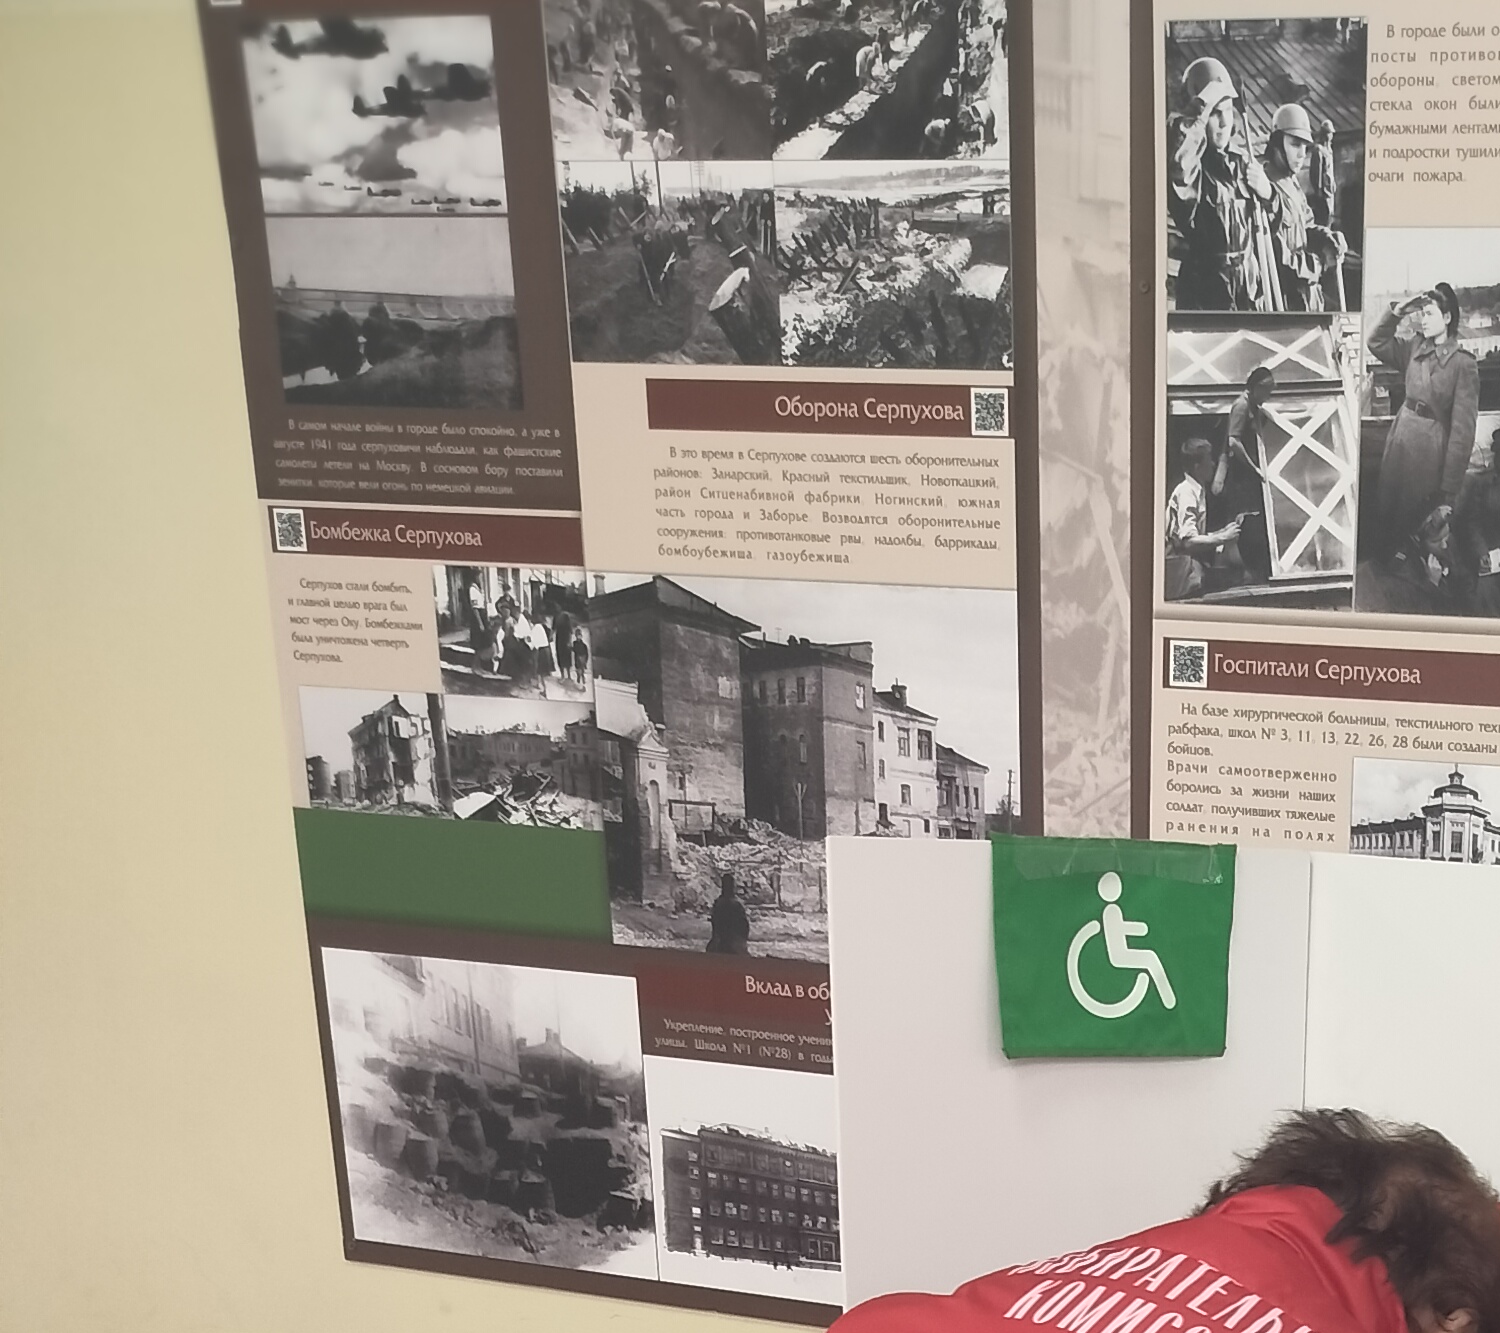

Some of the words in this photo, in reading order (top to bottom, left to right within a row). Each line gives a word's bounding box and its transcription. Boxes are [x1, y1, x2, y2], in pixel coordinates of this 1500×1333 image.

[1401, 27, 1447, 42] городе
[1451, 21, 1486, 38] были
[1370, 52, 1417, 64] посты
[1369, 100, 1413, 112] стекла
[1424, 100, 1457, 111] окон
[1369, 120, 1447, 139] бумажными
[1382, 148, 1450, 162] подростки
[1368, 171, 1405, 183] очаги
[775, 395, 859, 422] Оборона
[864, 398, 964, 424] Серпухова
[680, 449, 698, 459] это
[701, 450, 734, 462] время
[747, 448, 807, 464] Серпухове
[905, 452, 999, 468] оборонительных
[782, 469, 830, 485] Красный
[654, 486, 691, 500] район
[700, 487, 795, 502] Ситценабивной
[958, 498, 1001, 509] южная
[655, 508, 686, 518] часть
[694, 509, 734, 522] города
[822, 511, 888, 525] Возводятся
[898, 513, 1001, 530] оборонительные
[310, 521, 391, 542] Бомбежка
[395, 524, 482, 549] Серпухова
[736, 530, 831, 543] противотанковые
[1214, 653, 1309, 677] Госпитали
[1315, 659, 1421, 686] Серпухова
[1181, 702, 1198, 716] На
[1201, 703, 1229, 718] базе
[1233, 709, 1324, 723] хирургической
[1396, 718, 1474, 732] текстильного
[1228, 728, 1257, 739] школ
[1392, 735, 1409, 749] 28
[1412, 736, 1443, 751] были
[1447, 741, 1498, 754] созданы
[1167, 759, 1208, 775] Врачи
[1218, 766, 1337, 783] самоотверженно
[1166, 778, 1222, 795] боролись
[1230, 786, 1243, 797] за
[1252, 788, 1290, 799] жизни
[1298, 791, 1336, 803] наших
[1211, 805, 1281, 819] получивших
[1285, 810, 1336, 823] тяжелые
[1166, 821, 1239, 835] ранения
[1252, 827, 1271, 838] на
[1284, 829, 1335, 842] полях
[745, 975, 792, 997] Вклад
[795, 984, 805, 998] в
